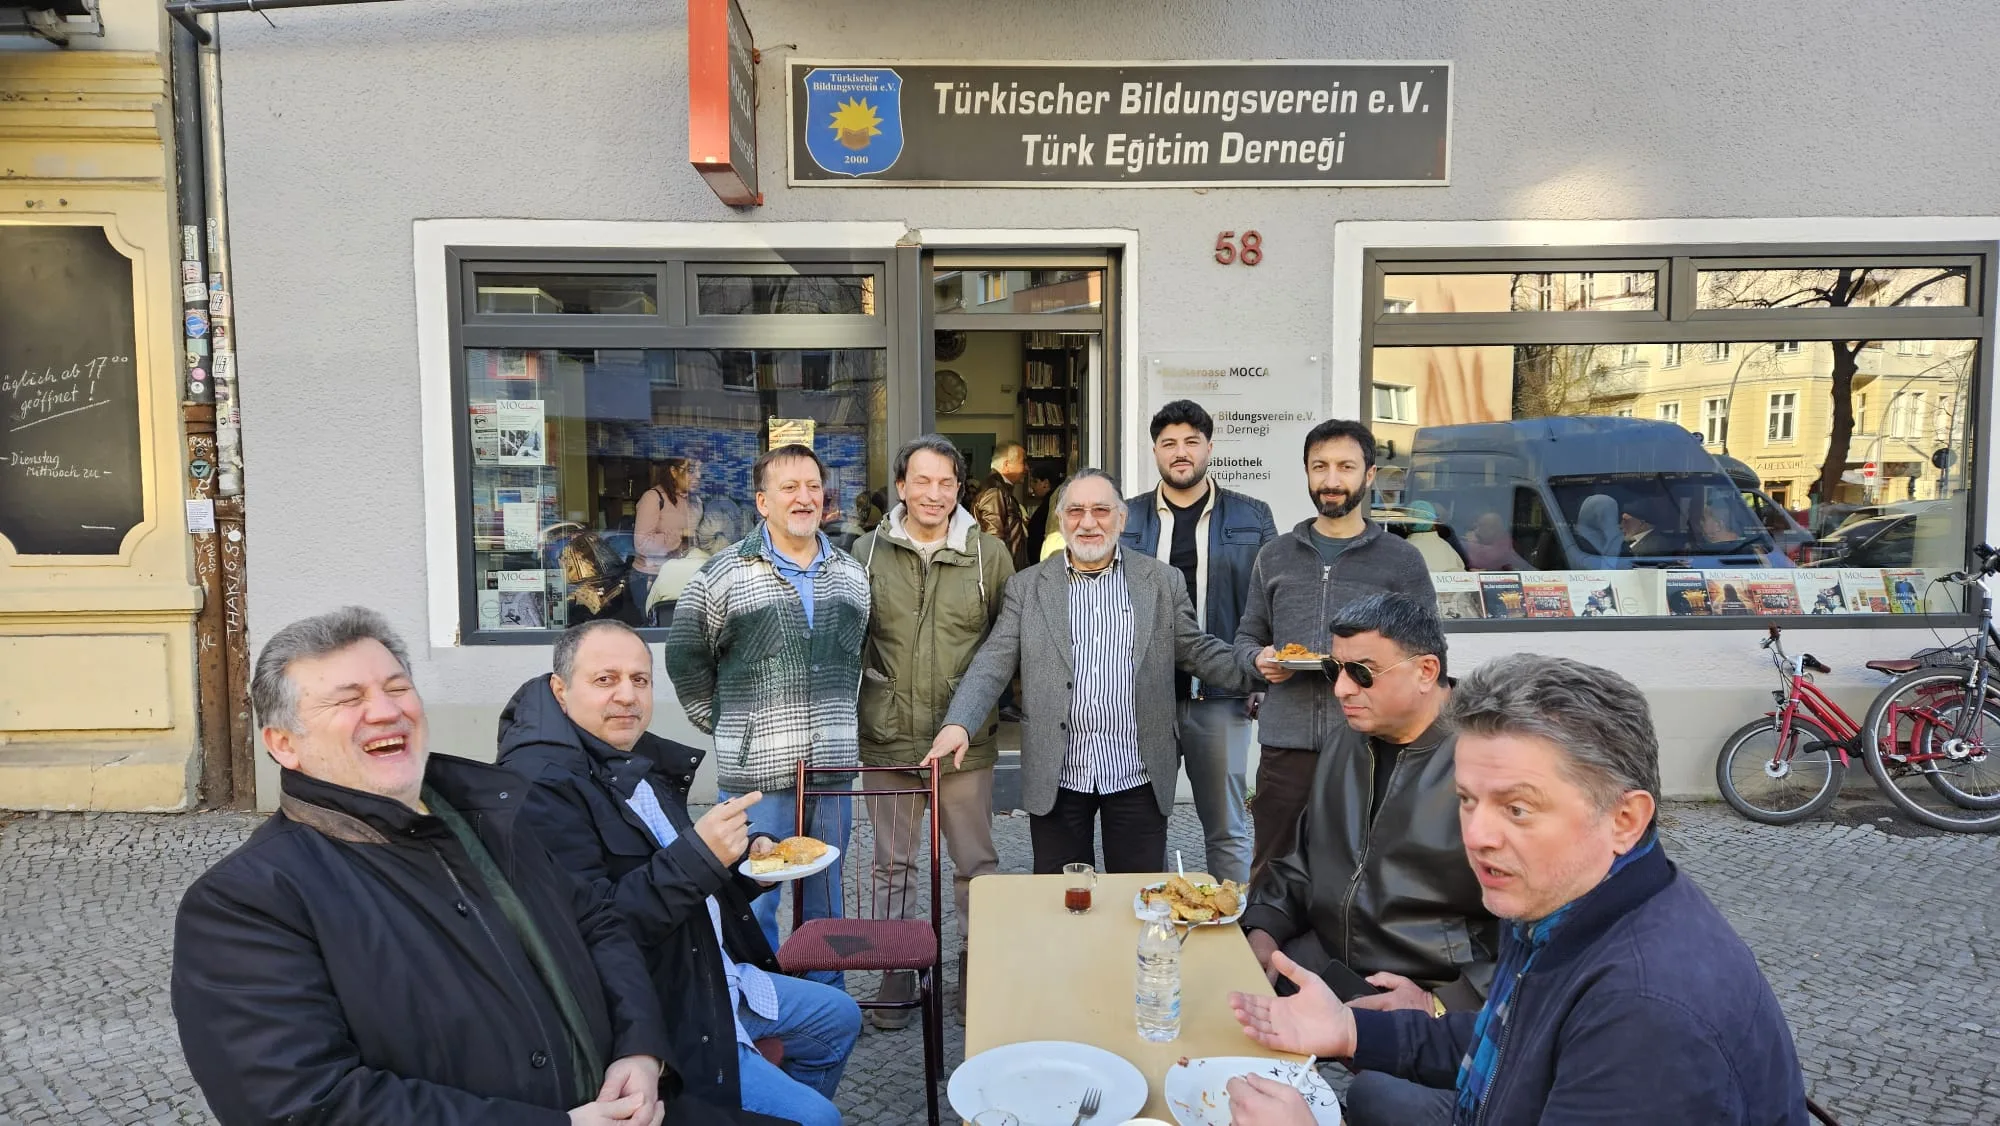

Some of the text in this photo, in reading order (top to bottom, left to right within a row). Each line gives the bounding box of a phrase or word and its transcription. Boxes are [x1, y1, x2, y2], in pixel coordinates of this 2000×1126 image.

[830, 73, 879, 83] Türkischer
[813, 81, 896, 93] Bildungsverein e.V.
[934, 81, 1430, 122] Türkischer Bildungsverein e.V.
[844, 155, 869, 164] 2000
[1021, 131, 1346, 175] Türk Eğitim Derneği
[1215, 230, 1262, 266] 58
[1229, 366, 1271, 378] MOCCA
[1, 365, 57, 399] äglich
[61, 363, 81, 380] ab
[1218, 410, 1294, 424] Bildungsverein
[1296, 411, 1317, 421] e.V.
[1207, 469, 1271, 484] ütüphanesi
